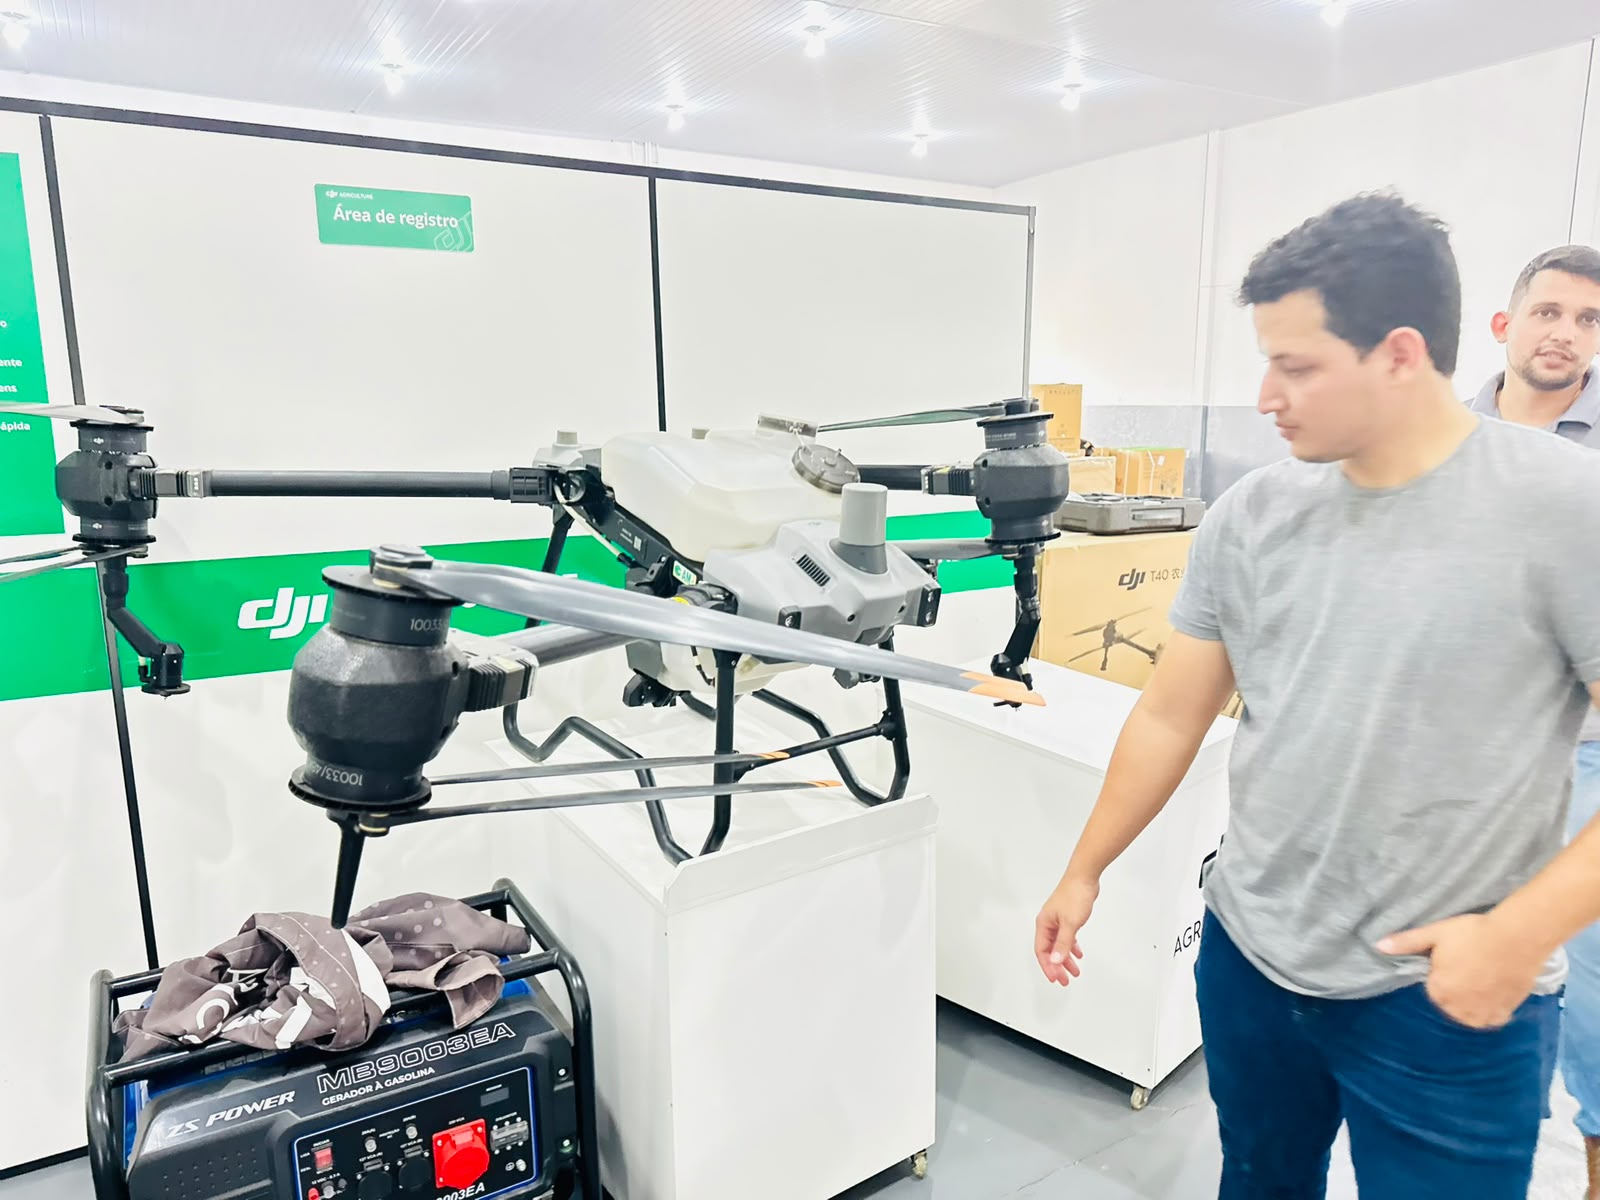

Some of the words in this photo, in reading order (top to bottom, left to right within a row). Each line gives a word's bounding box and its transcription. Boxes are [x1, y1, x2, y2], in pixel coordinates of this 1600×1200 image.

[333, 203, 371, 222] Área
[375, 209, 396, 224] de
[399, 212, 459, 230] registro
[0, 358, 23, 368] ente
[0, 384, 18, 393] ens
[0, 421, 31, 433] ápida
[1150, 569, 1169, 581] T40
[1173, 920, 1201, 957] AGR
[316, 1022, 517, 1094] MB9003EA
[322, 1085, 373, 1106] GERADOR
[374, 1080, 383, 1091] À
[384, 1067, 435, 1087] GASOLINA
[166, 1118, 200, 1138] ZS
[205, 1090, 296, 1128] POWER
[436, 1182, 486, 1200] 003EA
